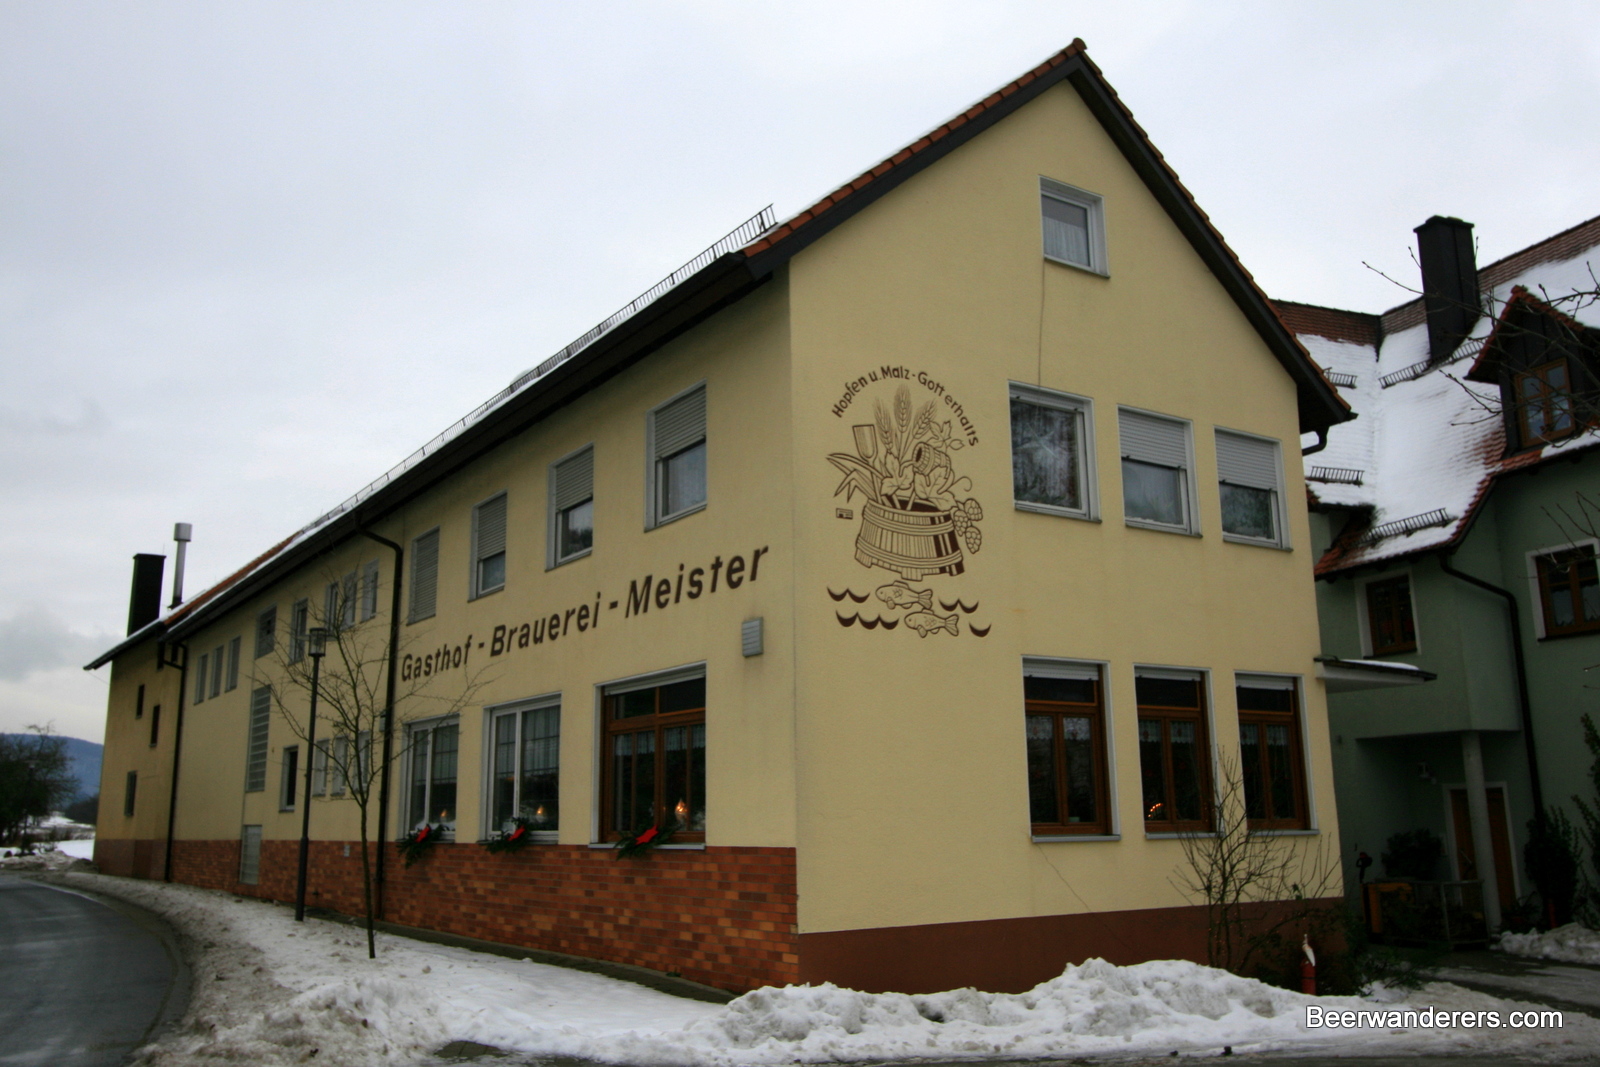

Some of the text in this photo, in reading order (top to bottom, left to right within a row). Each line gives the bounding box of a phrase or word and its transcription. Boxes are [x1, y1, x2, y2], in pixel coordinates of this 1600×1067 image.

[832, 377, 868, 418] Hopfen
[944, 394, 979, 447] erhalts
[401, 634, 473, 682] Gasthof
[490, 592, 601, 657] Brauerei
[625, 545, 769, 618] Meister
